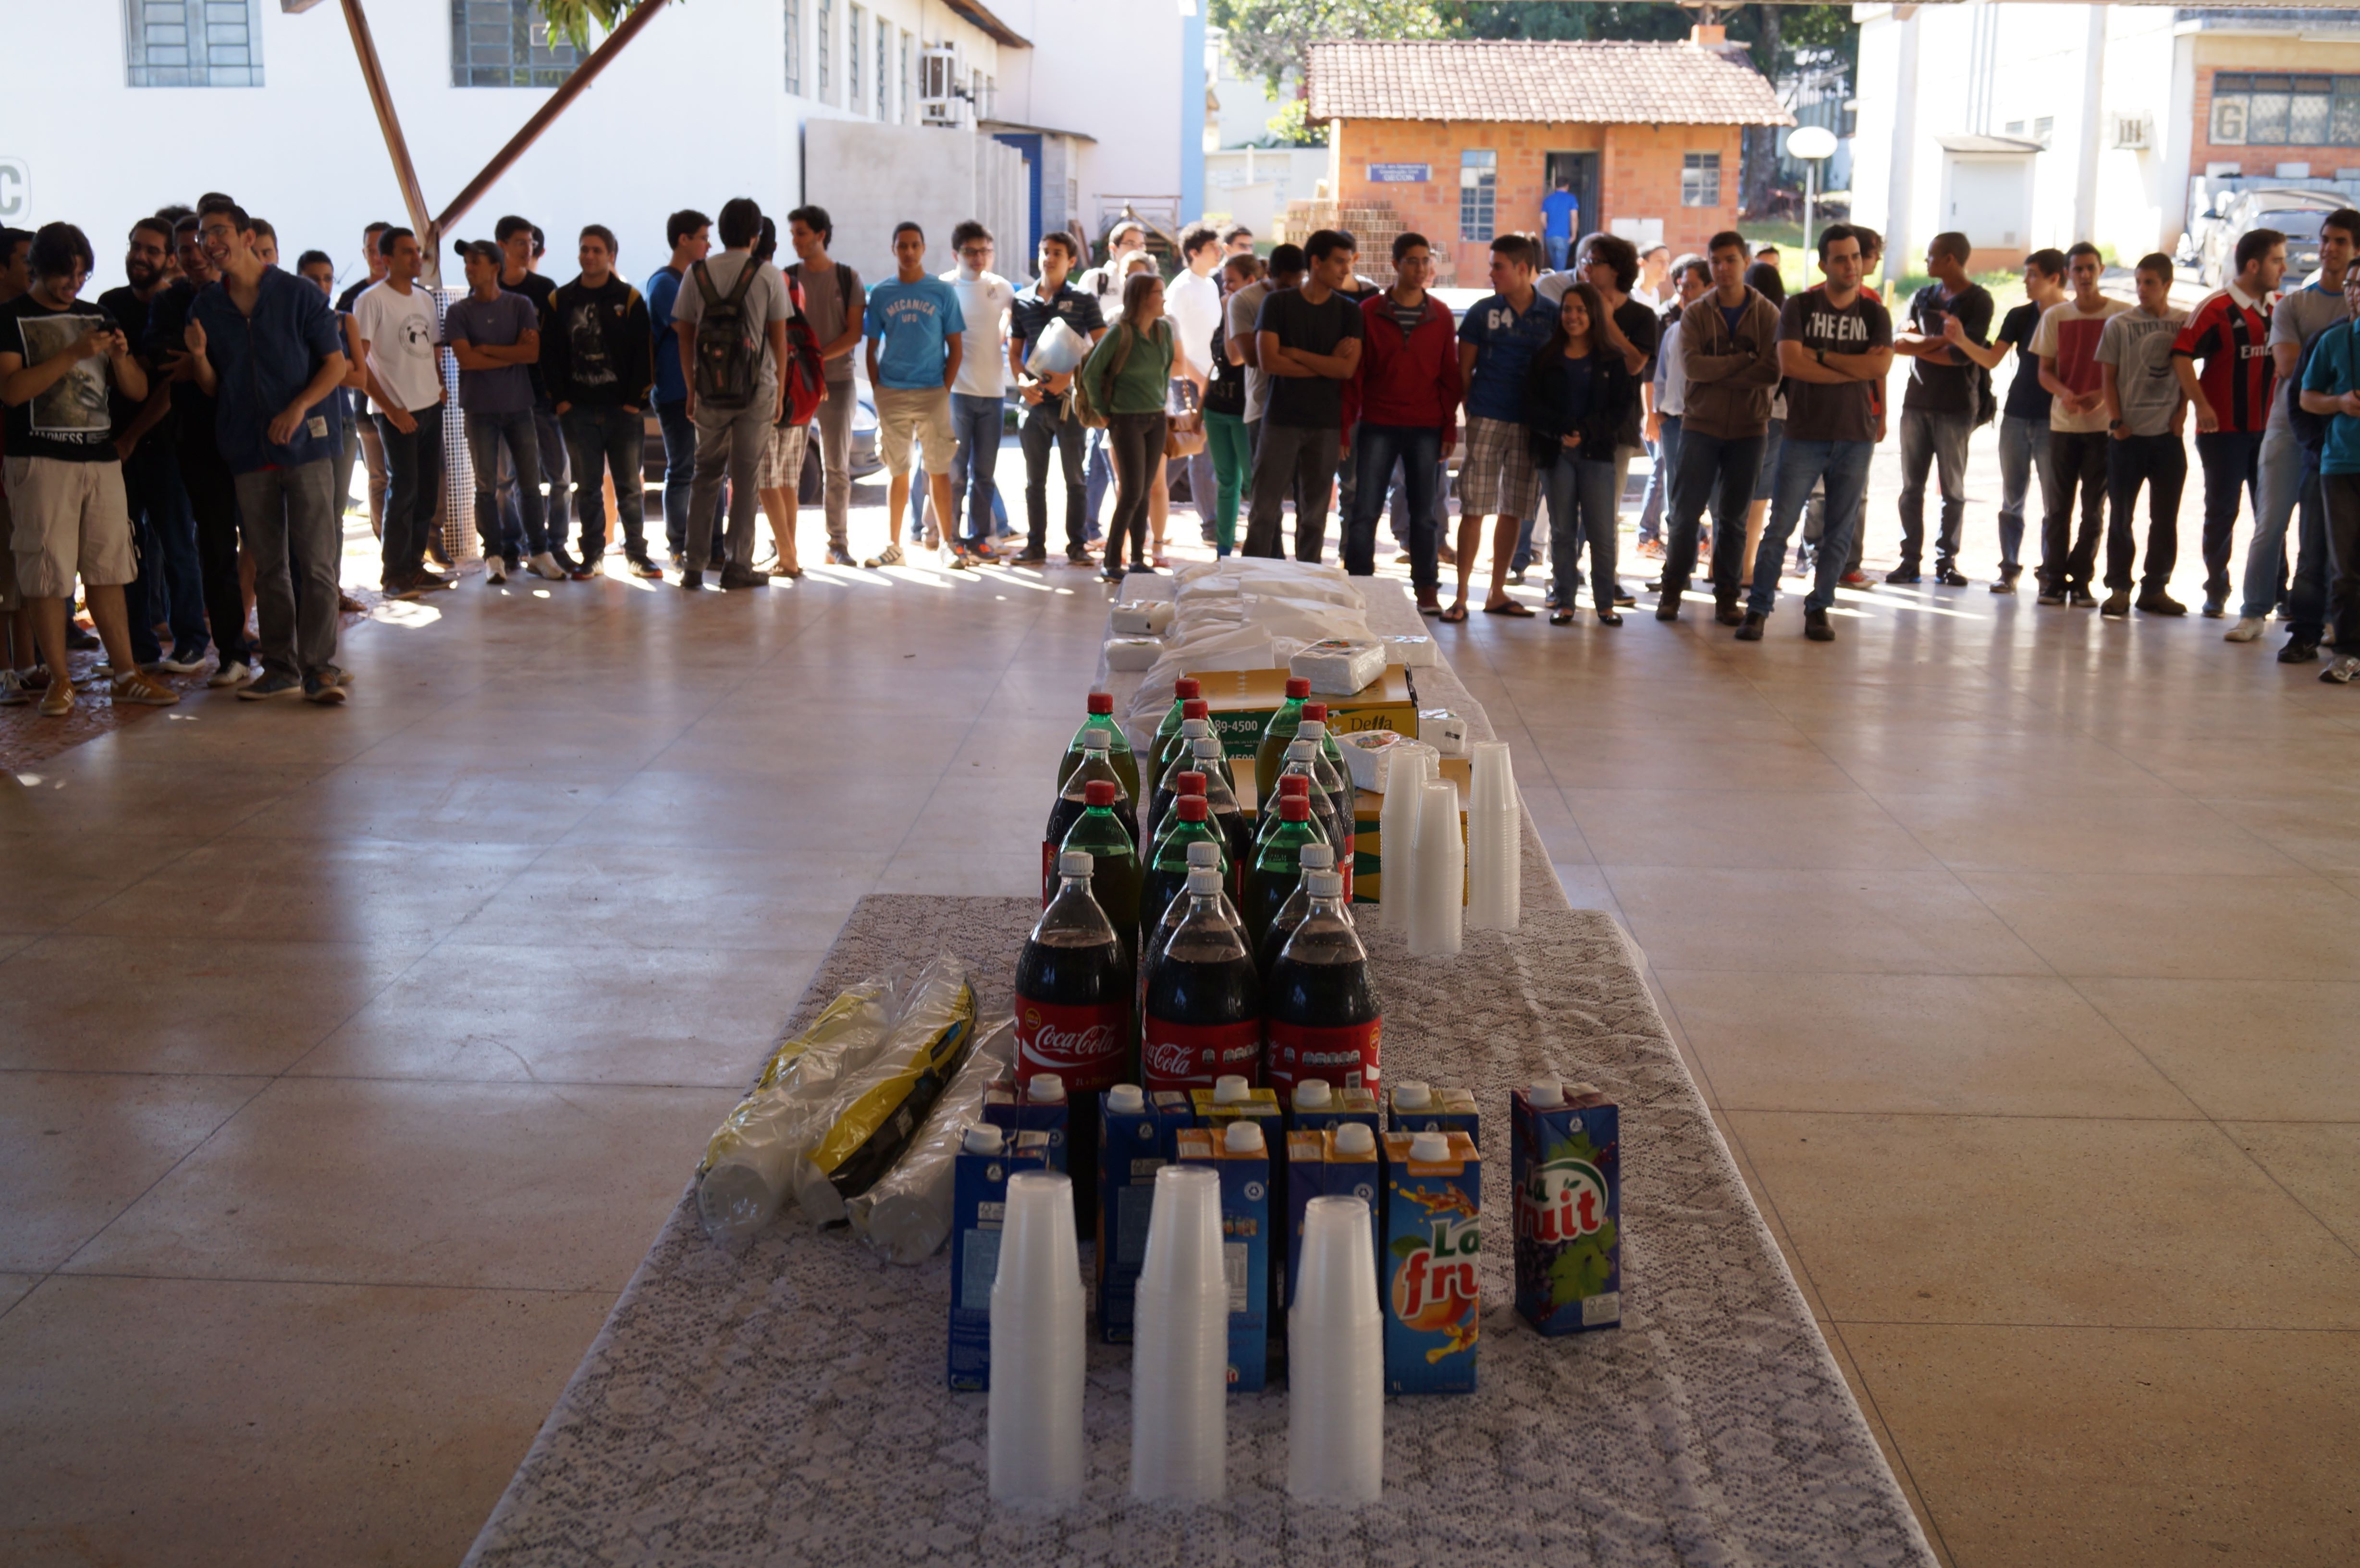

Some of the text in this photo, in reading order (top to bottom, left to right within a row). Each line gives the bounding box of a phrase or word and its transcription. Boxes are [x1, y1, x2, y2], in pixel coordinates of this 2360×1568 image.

[0, 165, 22, 216] C
[1488, 307, 1513, 329] 64
[1351, 715, 1392, 731] Della
[1035, 1024, 1118, 1054] Coca-Cola
[1403, 1251, 1479, 1316] fru
